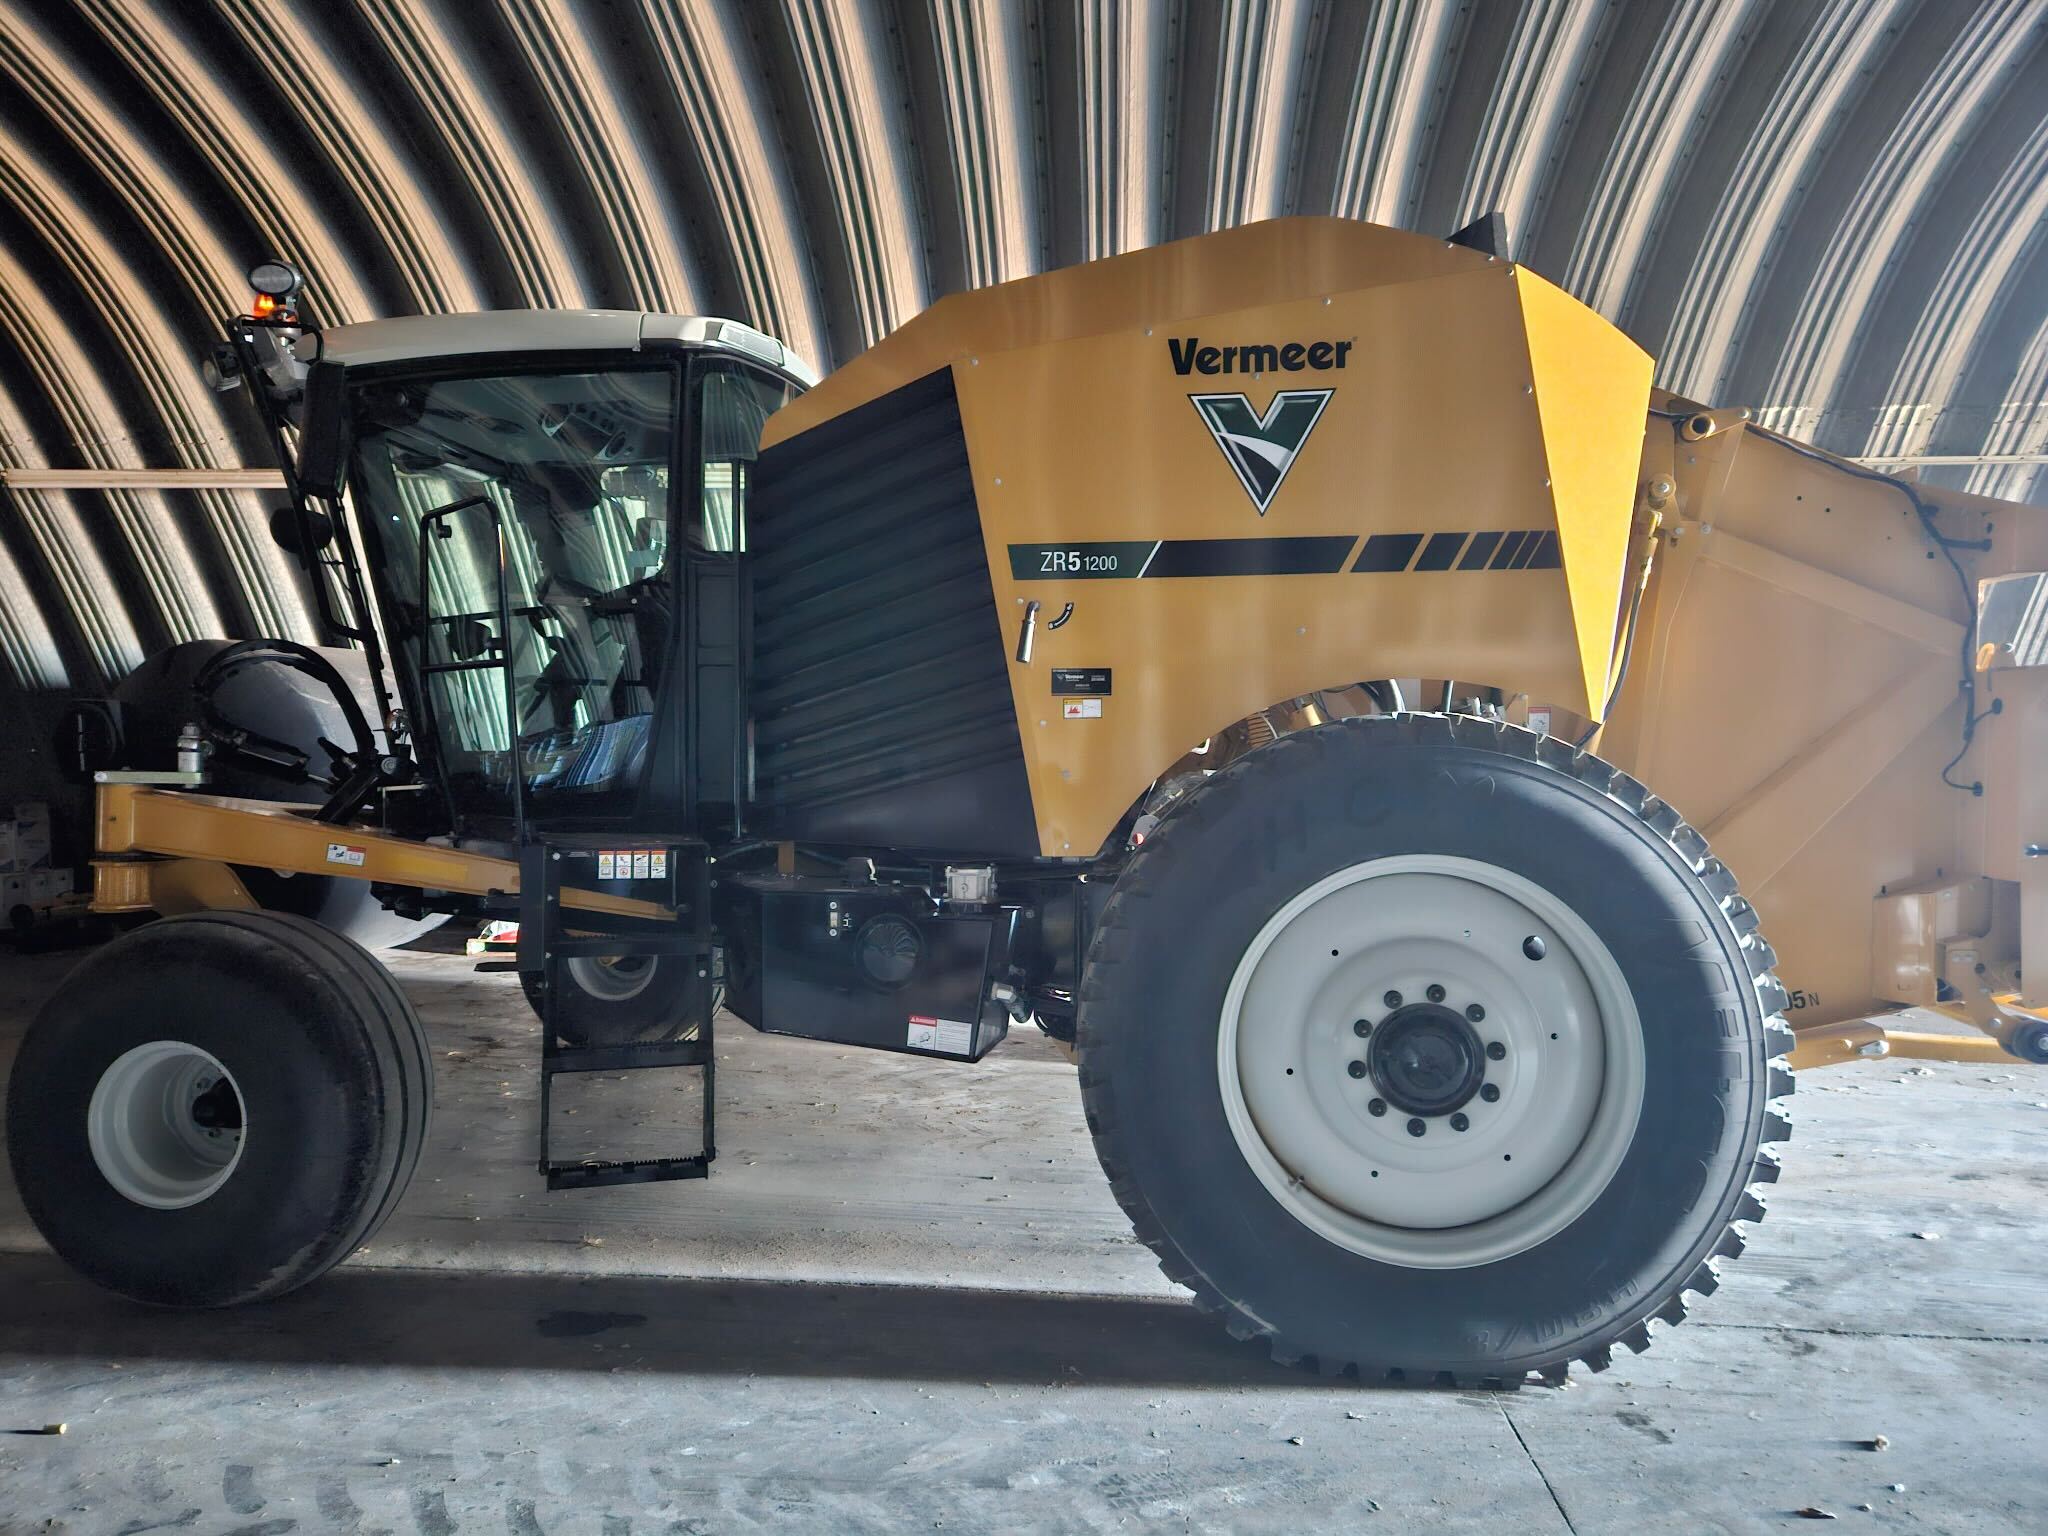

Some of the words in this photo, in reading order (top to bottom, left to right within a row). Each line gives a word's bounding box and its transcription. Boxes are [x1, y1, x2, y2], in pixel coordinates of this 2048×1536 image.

[1168, 337, 1353, 375] Vermeer
[1039, 551, 1082, 573] ZR5
[1083, 555, 1118, 572] 1200
